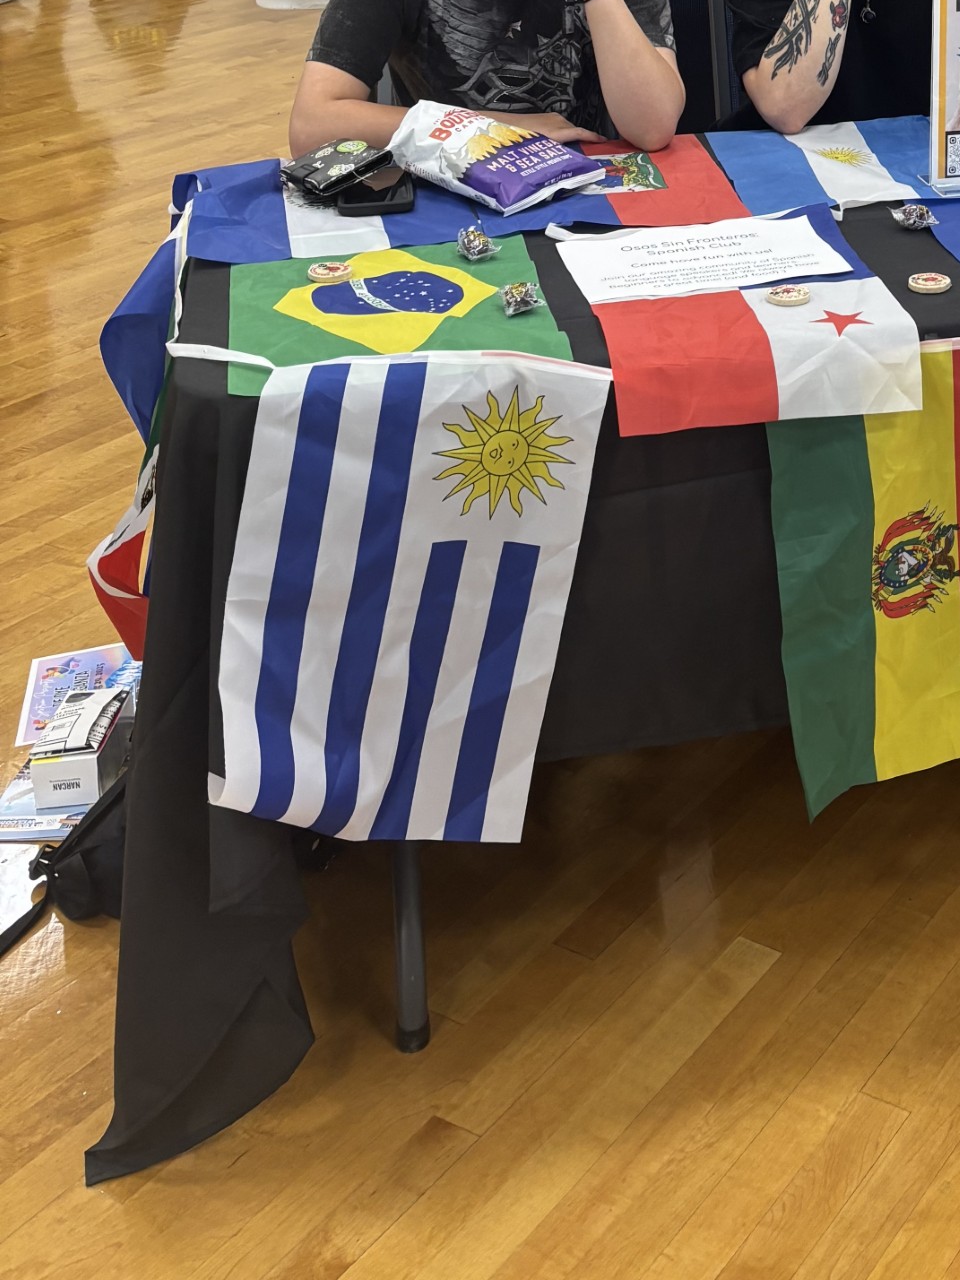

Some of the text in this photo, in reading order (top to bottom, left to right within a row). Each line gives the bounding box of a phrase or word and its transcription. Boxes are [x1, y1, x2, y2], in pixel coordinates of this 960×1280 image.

[486, 138, 561, 172] MALT VINEGA
[515, 155, 540, 169] SEA
[538, 145, 568, 160] SALT
[620, 232, 759, 252] Osos Sin Fronteras:
[646, 241, 742, 255] Spanish Club
[631, 260, 667, 268] Come
[649, 267, 697, 276] amazing
[699, 261, 757, 270] community
[772, 253, 815, 262] Spanish
[52, 781, 81, 791] NARCAN
